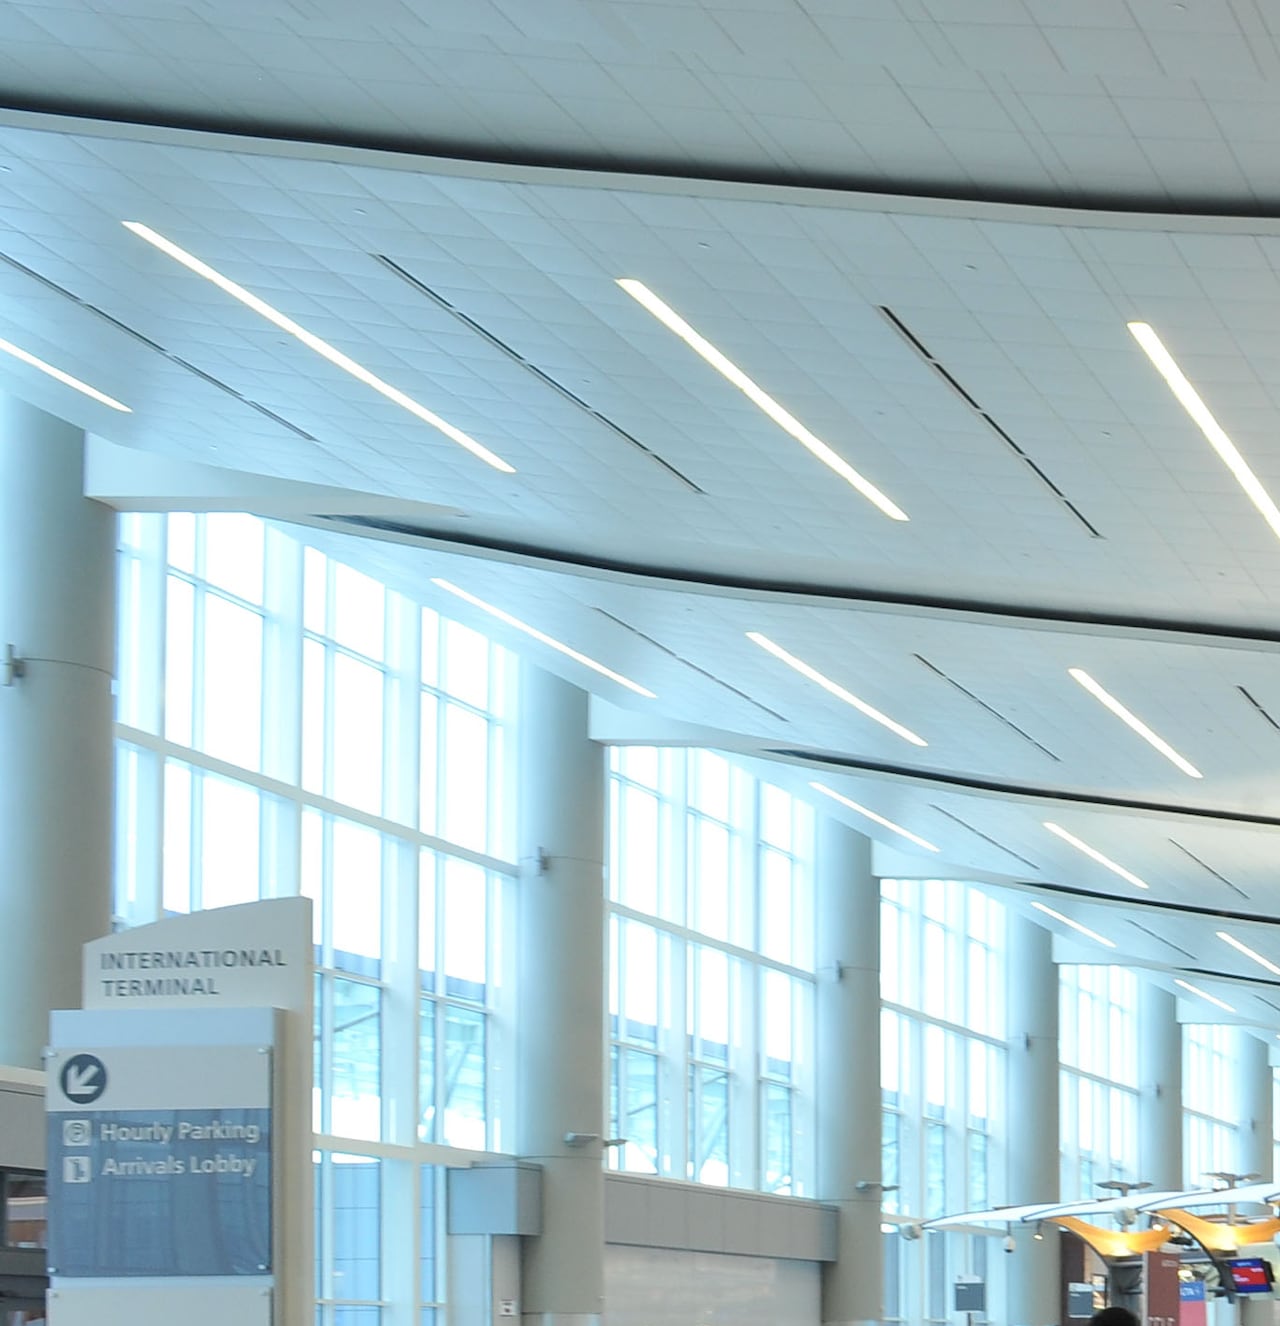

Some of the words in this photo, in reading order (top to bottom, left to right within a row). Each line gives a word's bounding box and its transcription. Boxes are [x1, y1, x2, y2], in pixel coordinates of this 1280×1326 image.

[100, 949, 287, 971] INTERNATIONAL
[101, 977, 219, 997] TERMINAL
[101, 1121, 172, 1144] Hourly
[178, 1119, 260, 1144] Parking
[102, 1155, 186, 1176] Arrivals
[190, 1154, 256, 1177] Lobby
